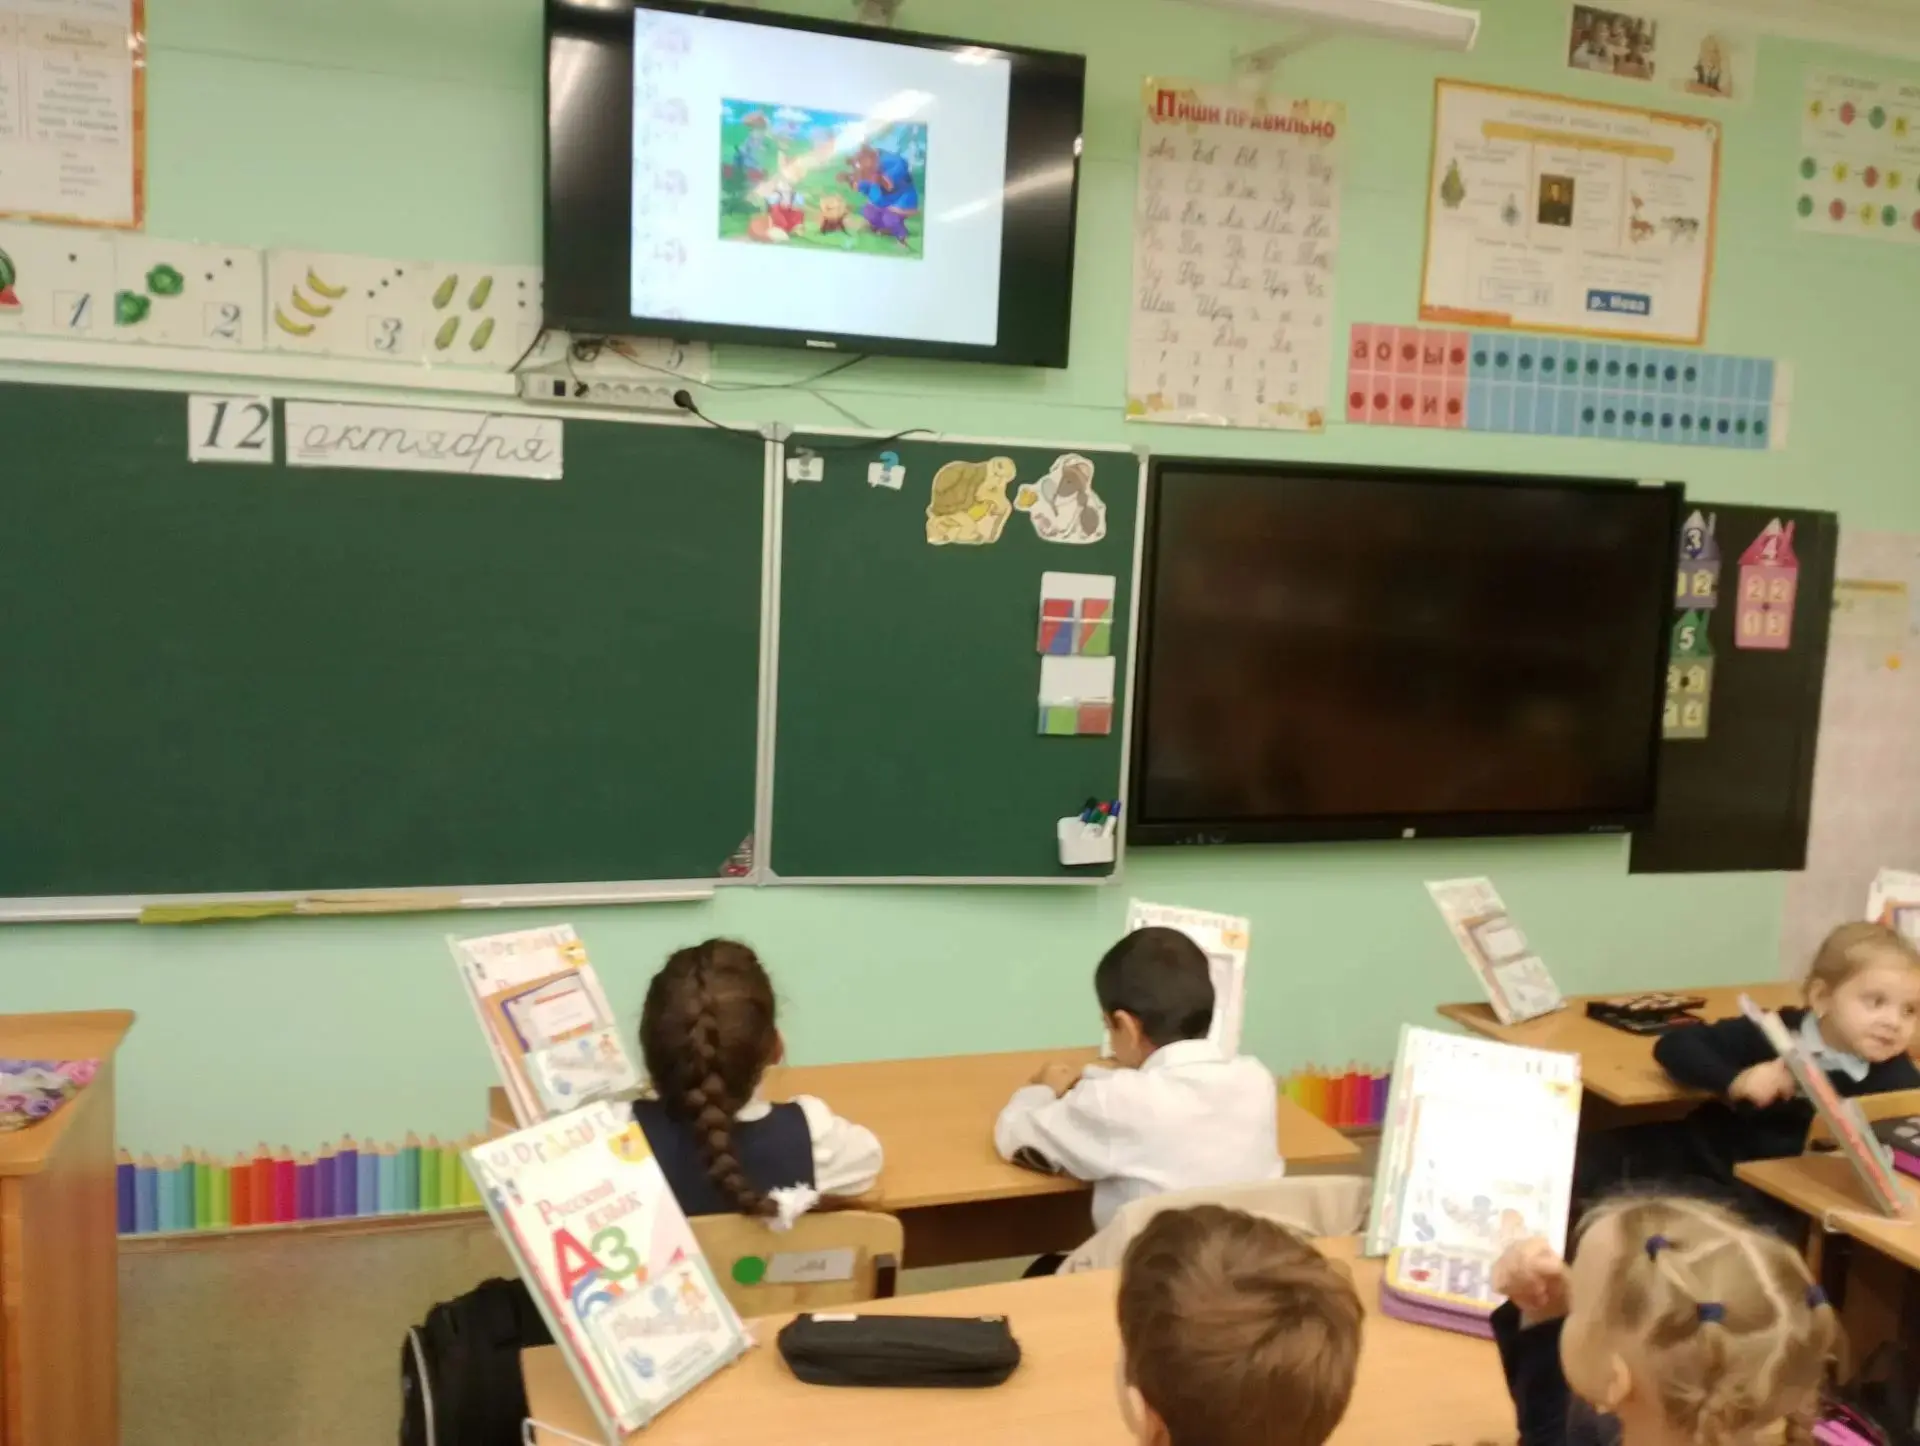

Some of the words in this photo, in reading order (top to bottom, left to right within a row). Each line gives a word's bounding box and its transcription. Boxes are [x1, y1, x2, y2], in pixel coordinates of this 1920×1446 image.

[211, 304, 242, 341] 2
[374, 317, 403, 354] 3
[1353, 340, 1369, 360] а
[1376, 341, 1392, 362] о
[1423, 346, 1444, 366] ы
[1423, 395, 1438, 415] и
[200, 400, 271, 450] 12
[1684, 528, 1703, 552] 3
[1679, 626, 1698, 651] 5
